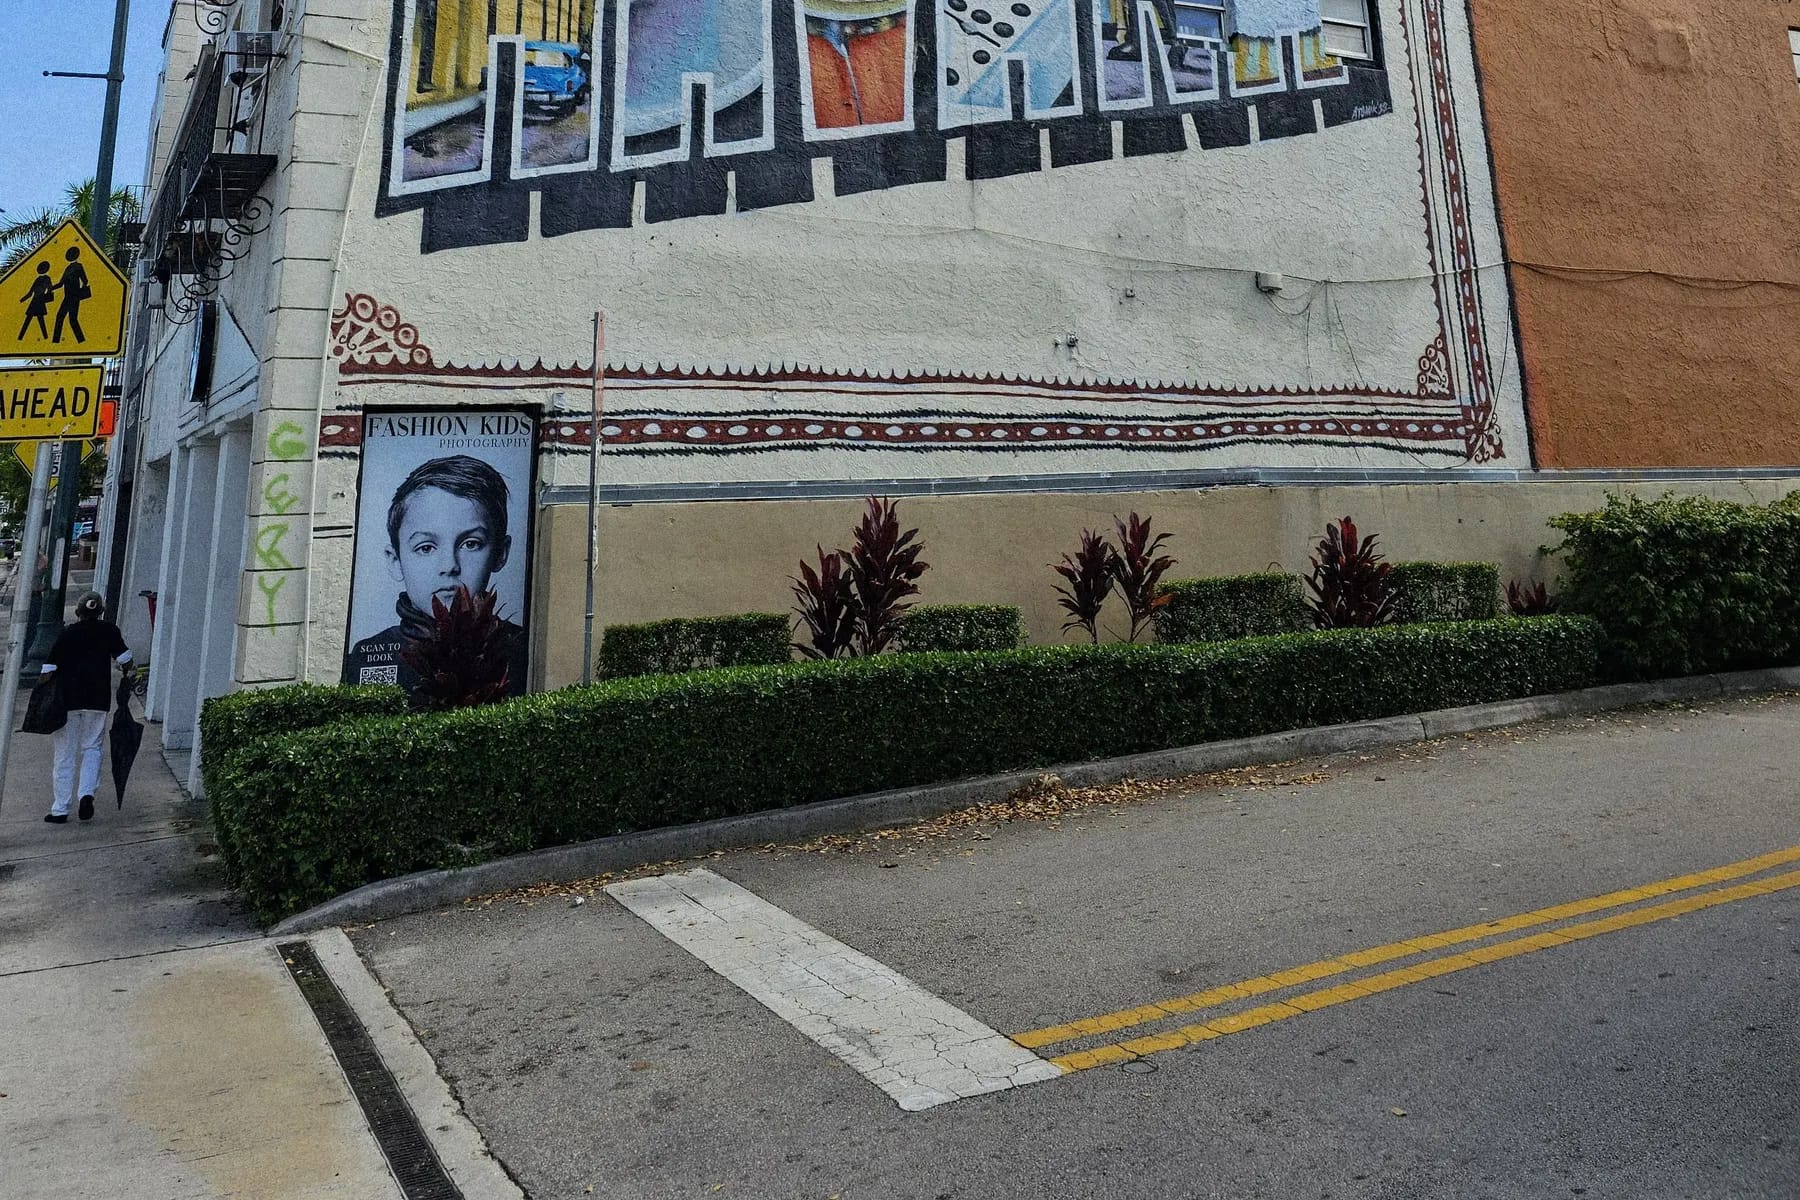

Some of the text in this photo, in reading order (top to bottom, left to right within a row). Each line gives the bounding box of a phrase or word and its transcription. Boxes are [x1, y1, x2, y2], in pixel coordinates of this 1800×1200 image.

[368, 415, 531, 437] FASHION KIDS
[439, 438, 529, 448] PHOTOGRAPHY
[360, 642, 401, 653] SCAN TO
[367, 653, 393, 662] BOOK
